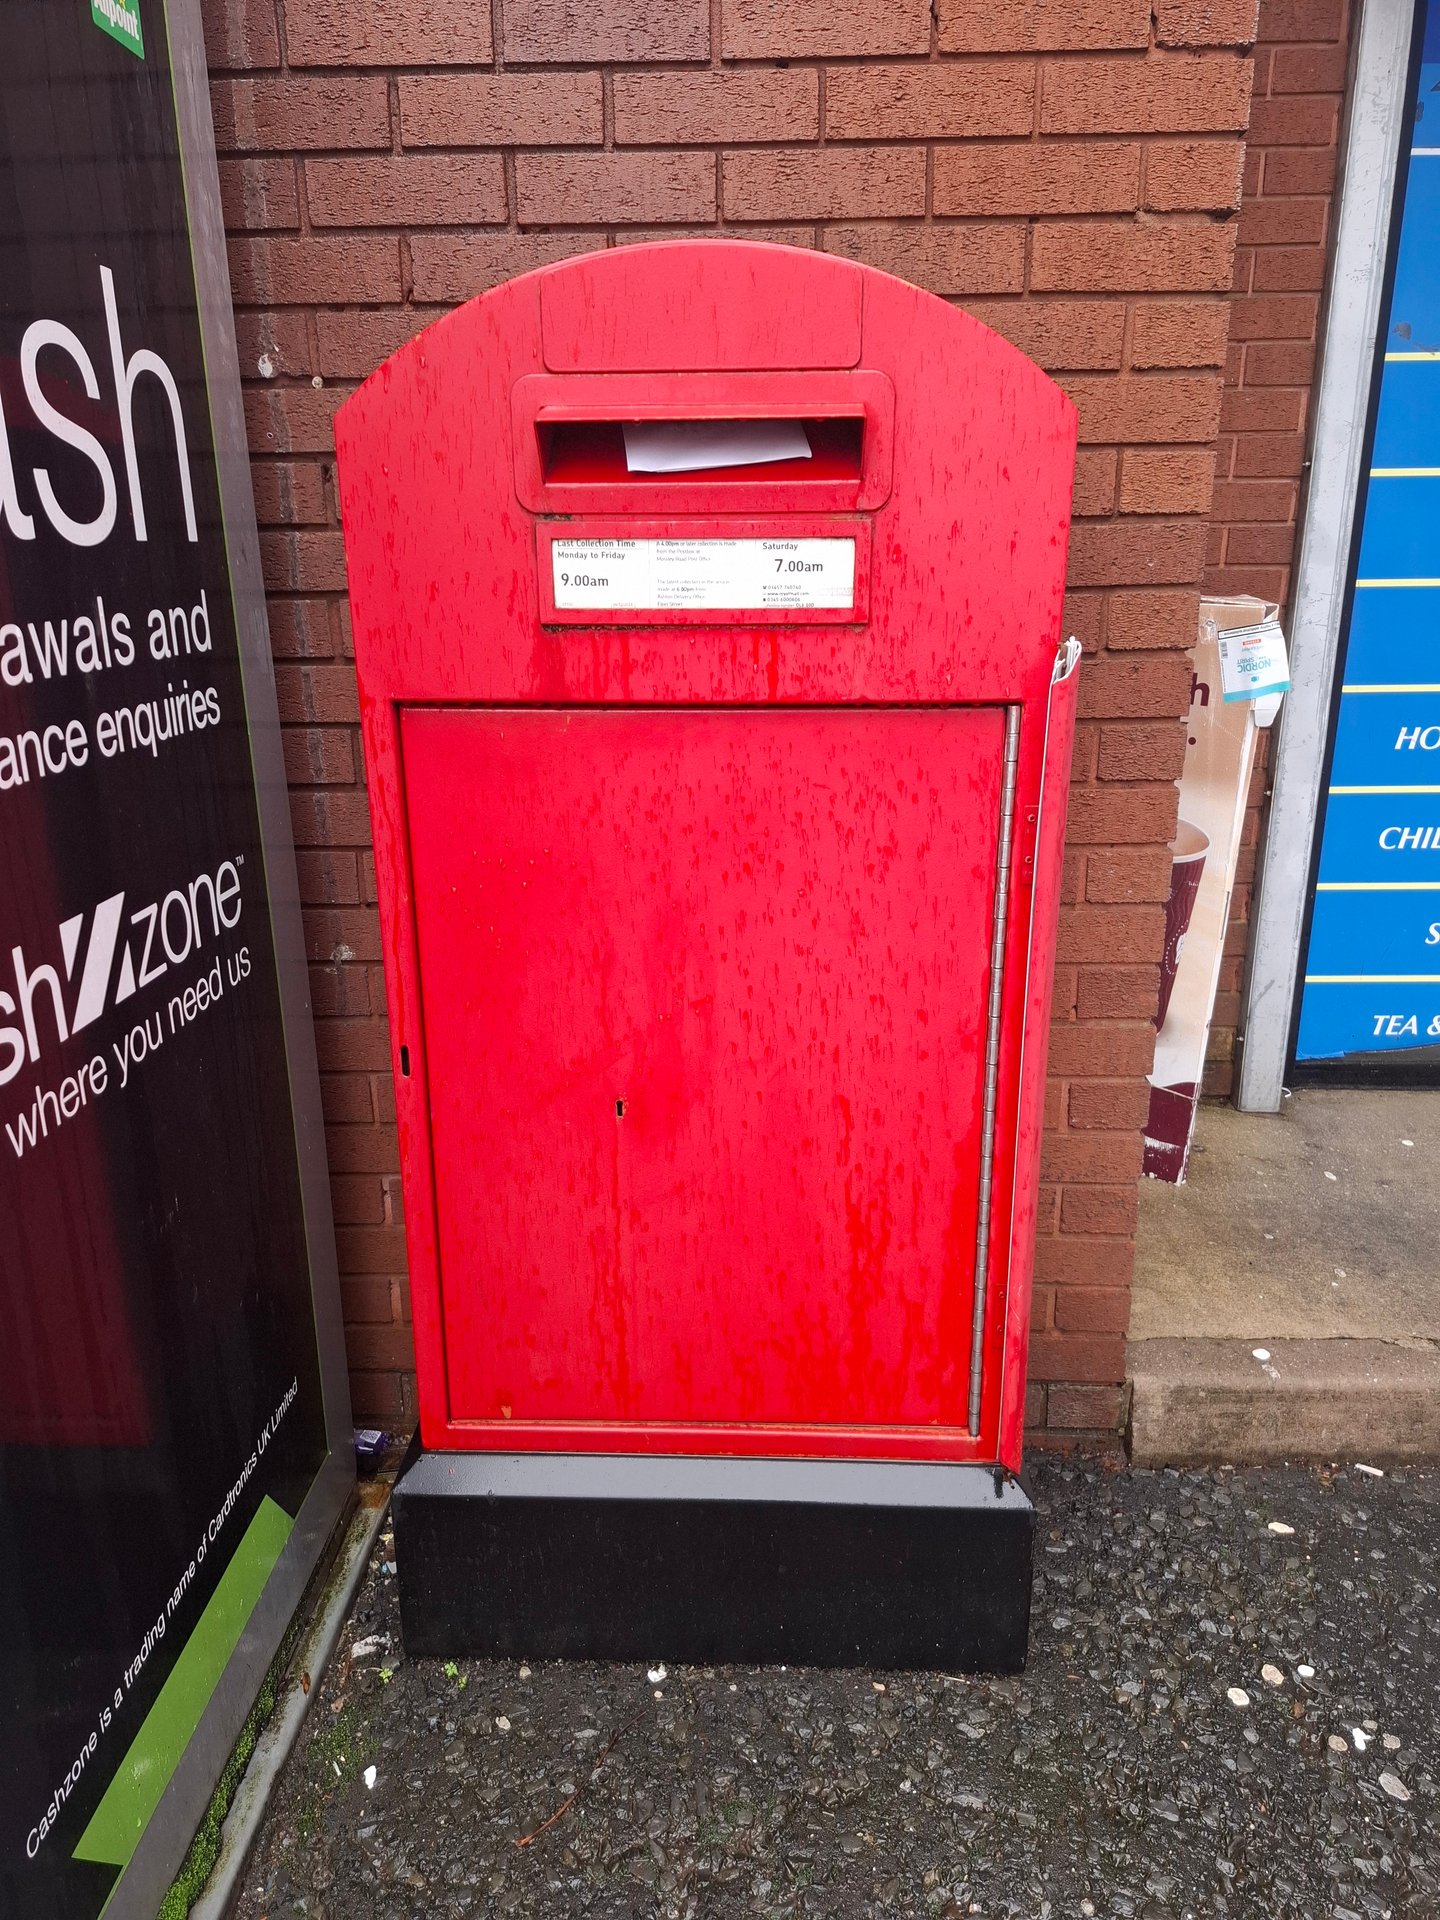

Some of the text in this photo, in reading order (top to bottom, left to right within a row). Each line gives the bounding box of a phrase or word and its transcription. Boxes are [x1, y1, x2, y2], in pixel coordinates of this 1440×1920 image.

[558, 551, 588, 560] Monday
[602, 551, 626, 560] Friday
[762, 542, 798, 551] Saturday
[775, 558, 824, 572] 7.00am
[561, 573, 609, 586] 9.00am
[0, 589, 212, 686] awals and
[1237, 658, 1271, 673] NORDIC
[0, 679, 221, 790] ance enquiries
[1373, 1015, 1418, 1036] TEA
[5, 947, 251, 1158] where you need us
[26, 1376, 298, 1858] Cashzone is a trading name of Cardtronics UK Limited
